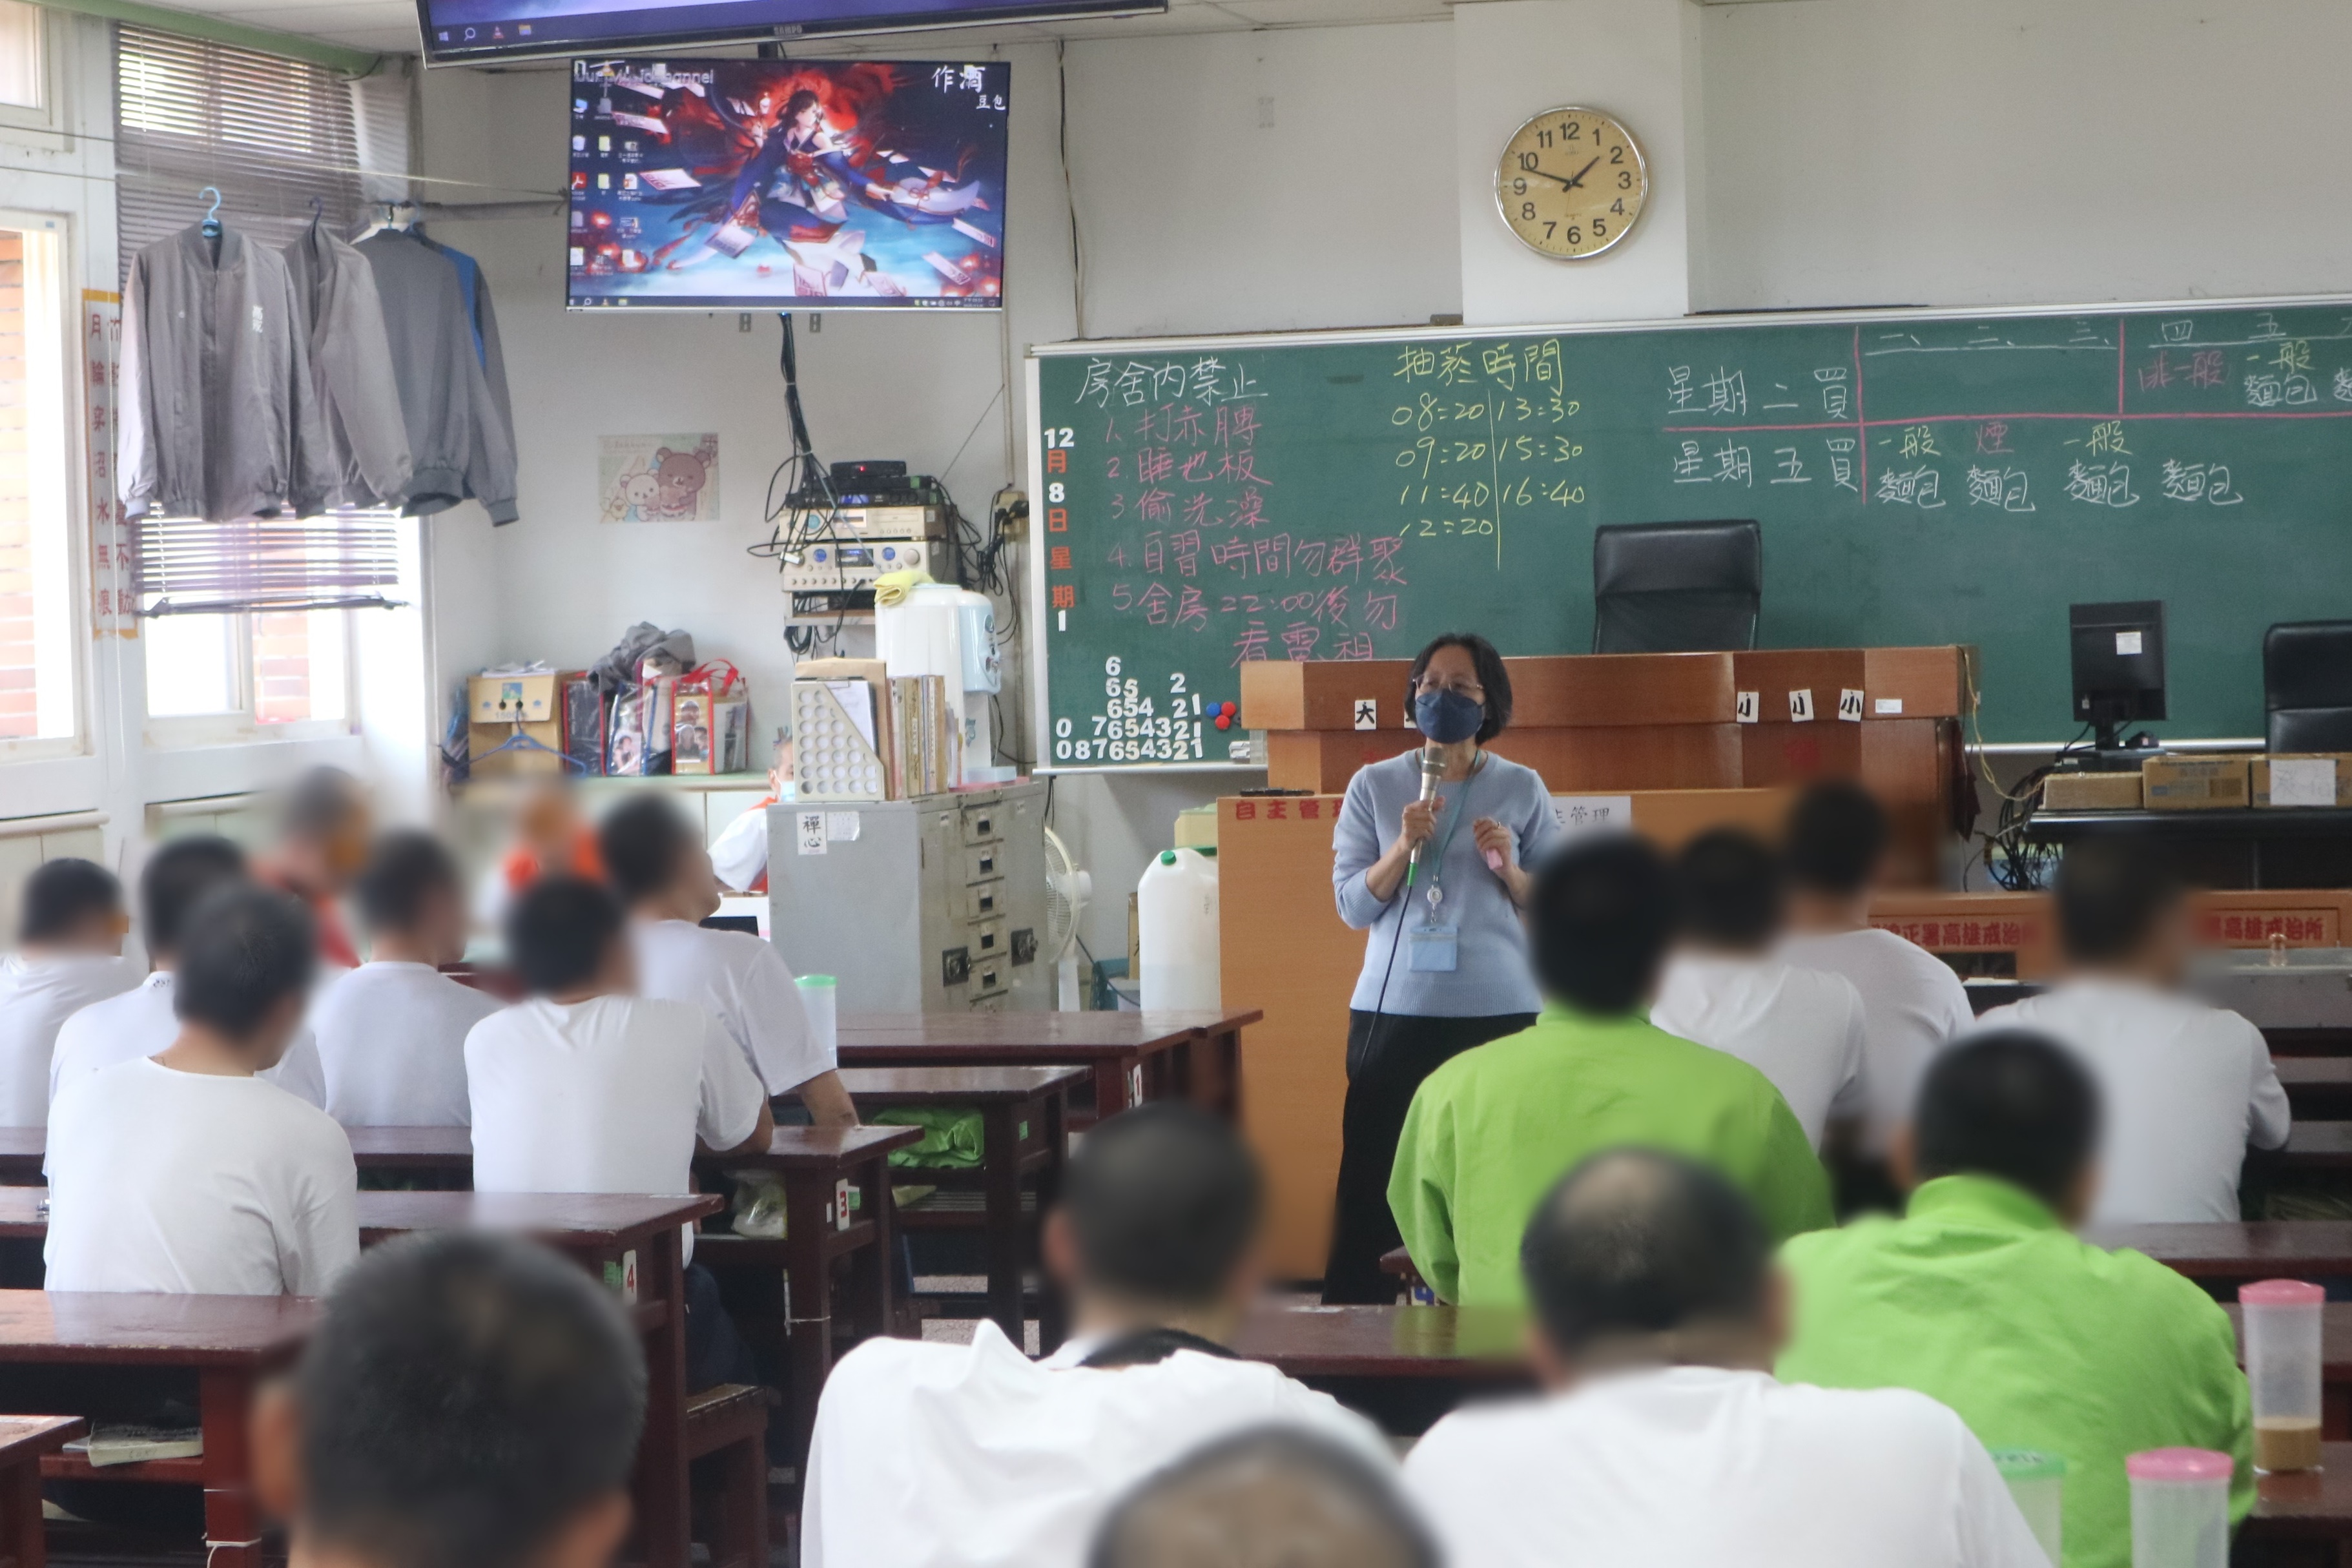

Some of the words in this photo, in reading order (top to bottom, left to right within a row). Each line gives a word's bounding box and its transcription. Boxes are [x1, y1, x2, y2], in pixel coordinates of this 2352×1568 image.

[976, 94, 1006, 110] 豆包
[1537, 130, 1552, 148] 11
[1560, 122, 1580, 140] 12
[1593, 129, 1600, 146] 1
[1518, 152, 1538, 170] 10
[1610, 147, 1624, 164] 2
[1513, 178, 1527, 196] 9
[1618, 172, 1631, 189] 3
[1522, 203, 1535, 220] 8
[1610, 198, 1624, 215] 4
[1543, 222, 1556, 239] 7
[1567, 227, 1580, 244] 6
[1593, 219, 1606, 236] 5
[2248, 313, 2287, 339] 五
[2246, 340, 2315, 374] 一般
[1668, 366, 1848, 418] 星期二買
[2245, 374, 2318, 407] 麵包
[1392, 392, 1485, 431] 08:20
[1498, 397, 1580, 423] 13:30
[1878, 425, 1941, 460] 一般
[2063, 420, 2133, 457] 一般
[1396, 437, 1486, 480] 09:20
[1498, 435, 1583, 462] 15:30
[1674, 438, 1859, 493] 星期五買
[1400, 481, 1490, 510] 11:40
[1502, 476, 1585, 507] 16:40
[1875, 464, 1946, 509] 麵包
[1966, 464, 2036, 512] 麵包
[2063, 458, 2140, 508] 麵包
[2161, 458, 2244, 506] 麵包
[1399, 518, 1494, 537] 12:20
[1105, 656, 1121, 676] 6
[1356, 701, 1374, 724] 大
[803, 816, 821, 848] 禪心
[627, 1263, 635, 1294] 4
